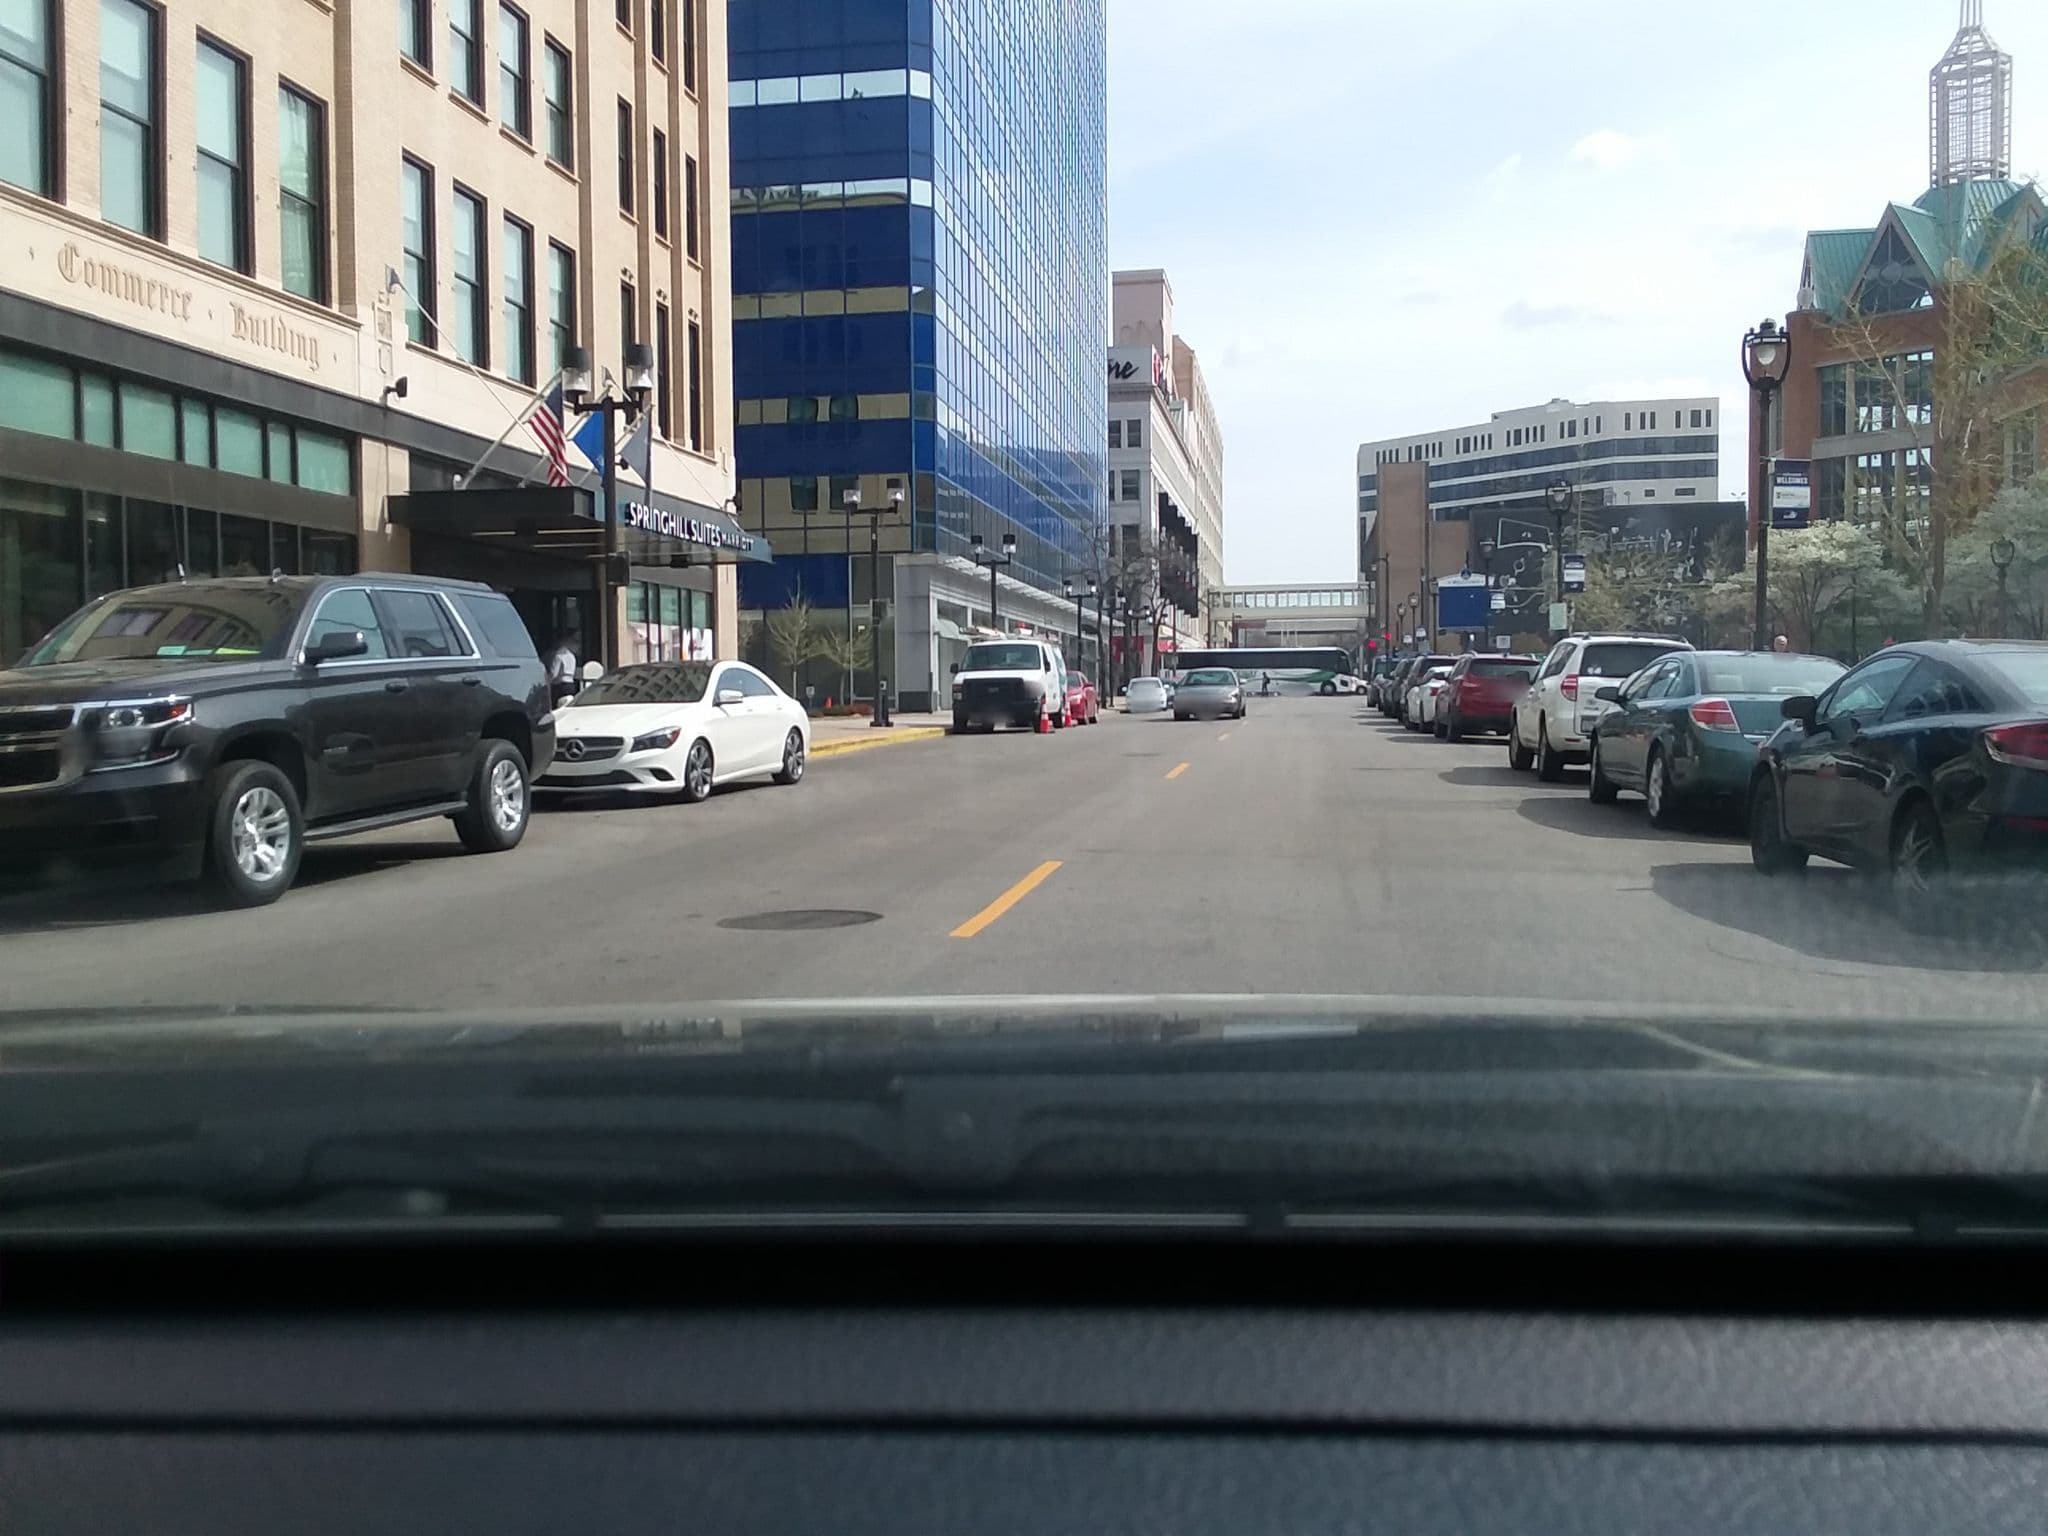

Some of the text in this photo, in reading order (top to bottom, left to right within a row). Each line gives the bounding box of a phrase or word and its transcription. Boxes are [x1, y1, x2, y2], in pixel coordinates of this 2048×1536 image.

[57, 240, 321, 372] Commerce Building
[629, 501, 690, 540] SPRINGHILL
[690, 519, 721, 548] SUITES
